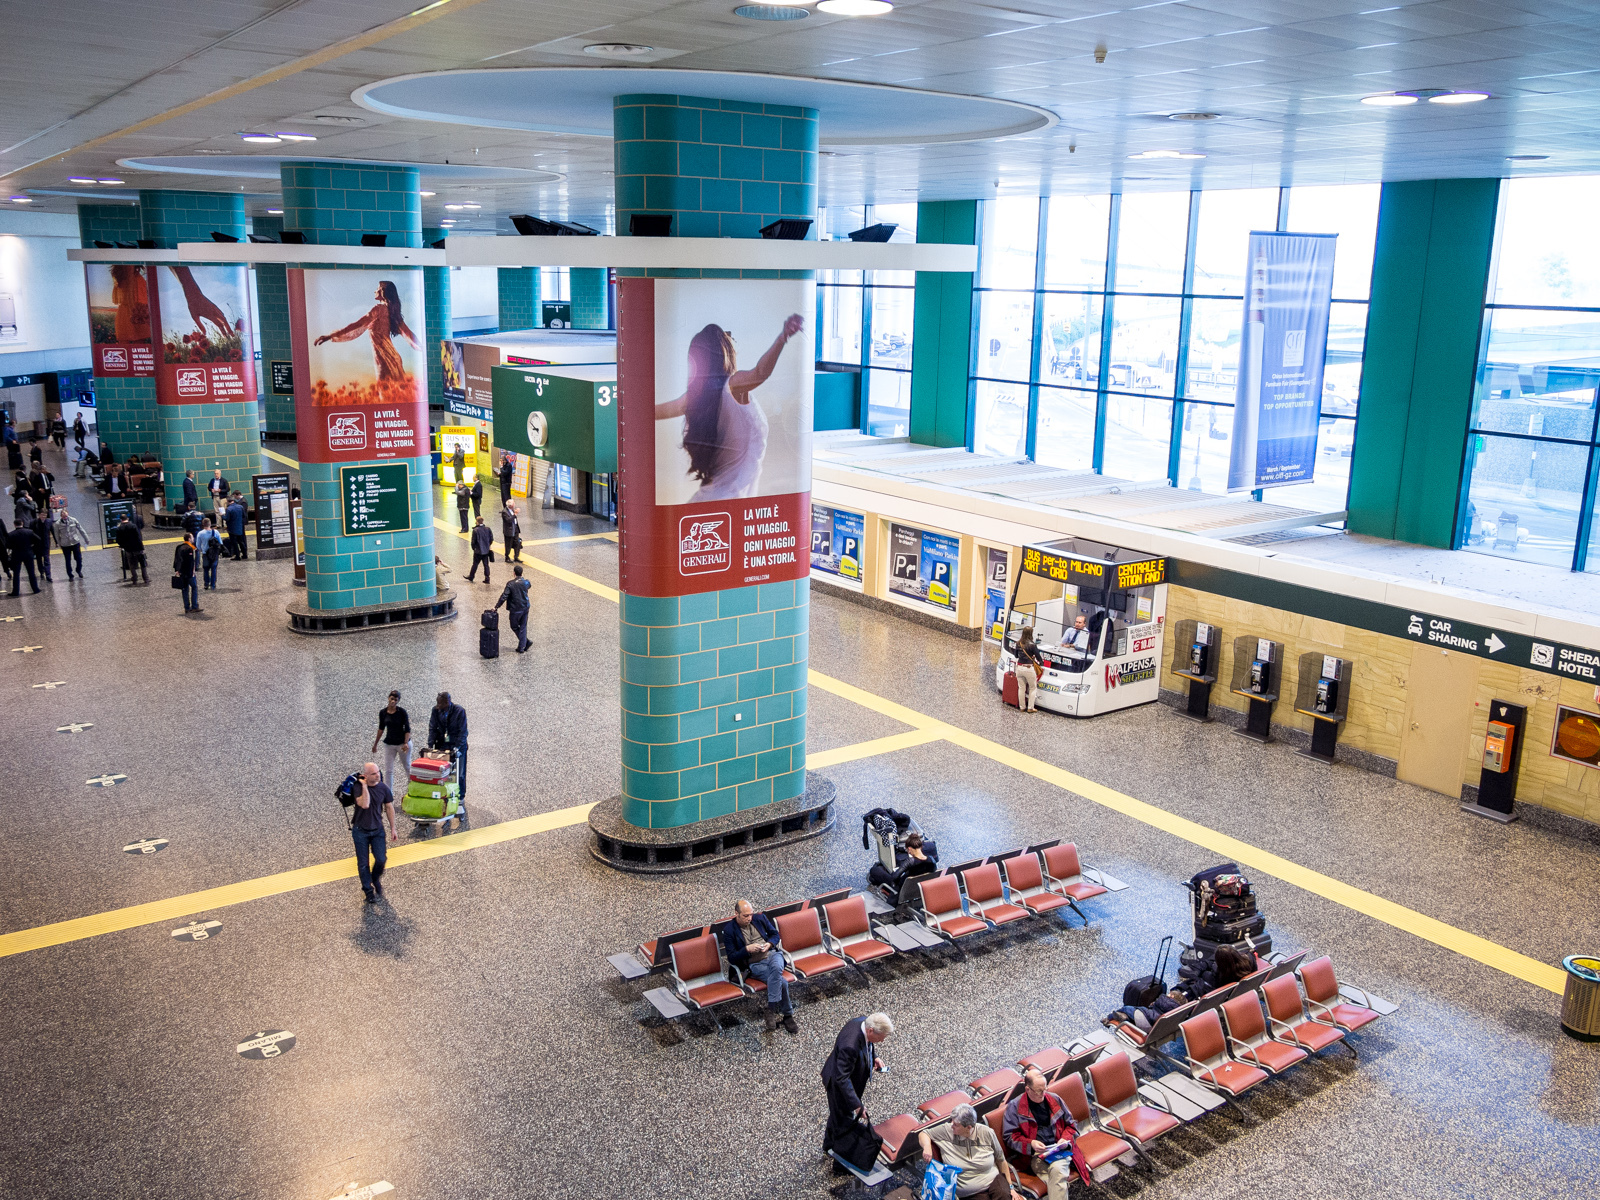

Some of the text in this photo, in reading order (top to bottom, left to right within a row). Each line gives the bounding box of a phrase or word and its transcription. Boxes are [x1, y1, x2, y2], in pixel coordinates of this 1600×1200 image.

[23, 376, 30, 384] P1
[536, 378, 543, 396] 3
[598, 386, 611, 406] 3
[1275, 401, 1314, 409] OPPORTUNITIES
[376, 440, 380, 448] È
[744, 504, 779, 520] LA VITA È
[744, 521, 790, 536] UN VIAGGIO.
[744, 536, 796, 552] OGNI VIAGGIO
[812, 533, 822, 551] P
[845, 538, 856, 554] P
[683, 553, 726, 567] GENERALI
[744, 552, 796, 568] È UNA STORIA.
[896, 556, 906, 574] P
[1028, 549, 1102, 576] BUS per-to MILANO
[1118, 560, 1164, 575] CENTRALE E
[744, 574, 770, 582] GENERALI.COM
[935, 562, 947, 580] P
[1050, 567, 1068, 580] ORIO
[1119, 572, 1160, 588] ATION AND
[1430, 620, 1451, 633] CAR
[1428, 631, 1477, 650] SHARING
[1559, 649, 1600, 666] SHERA
[1105, 657, 1156, 693] MALPENSA
[1121, 669, 1155, 683] SHUTTLE
[1558, 661, 1596, 678] HOTEL
[248, 1034, 281, 1047] MILANO
